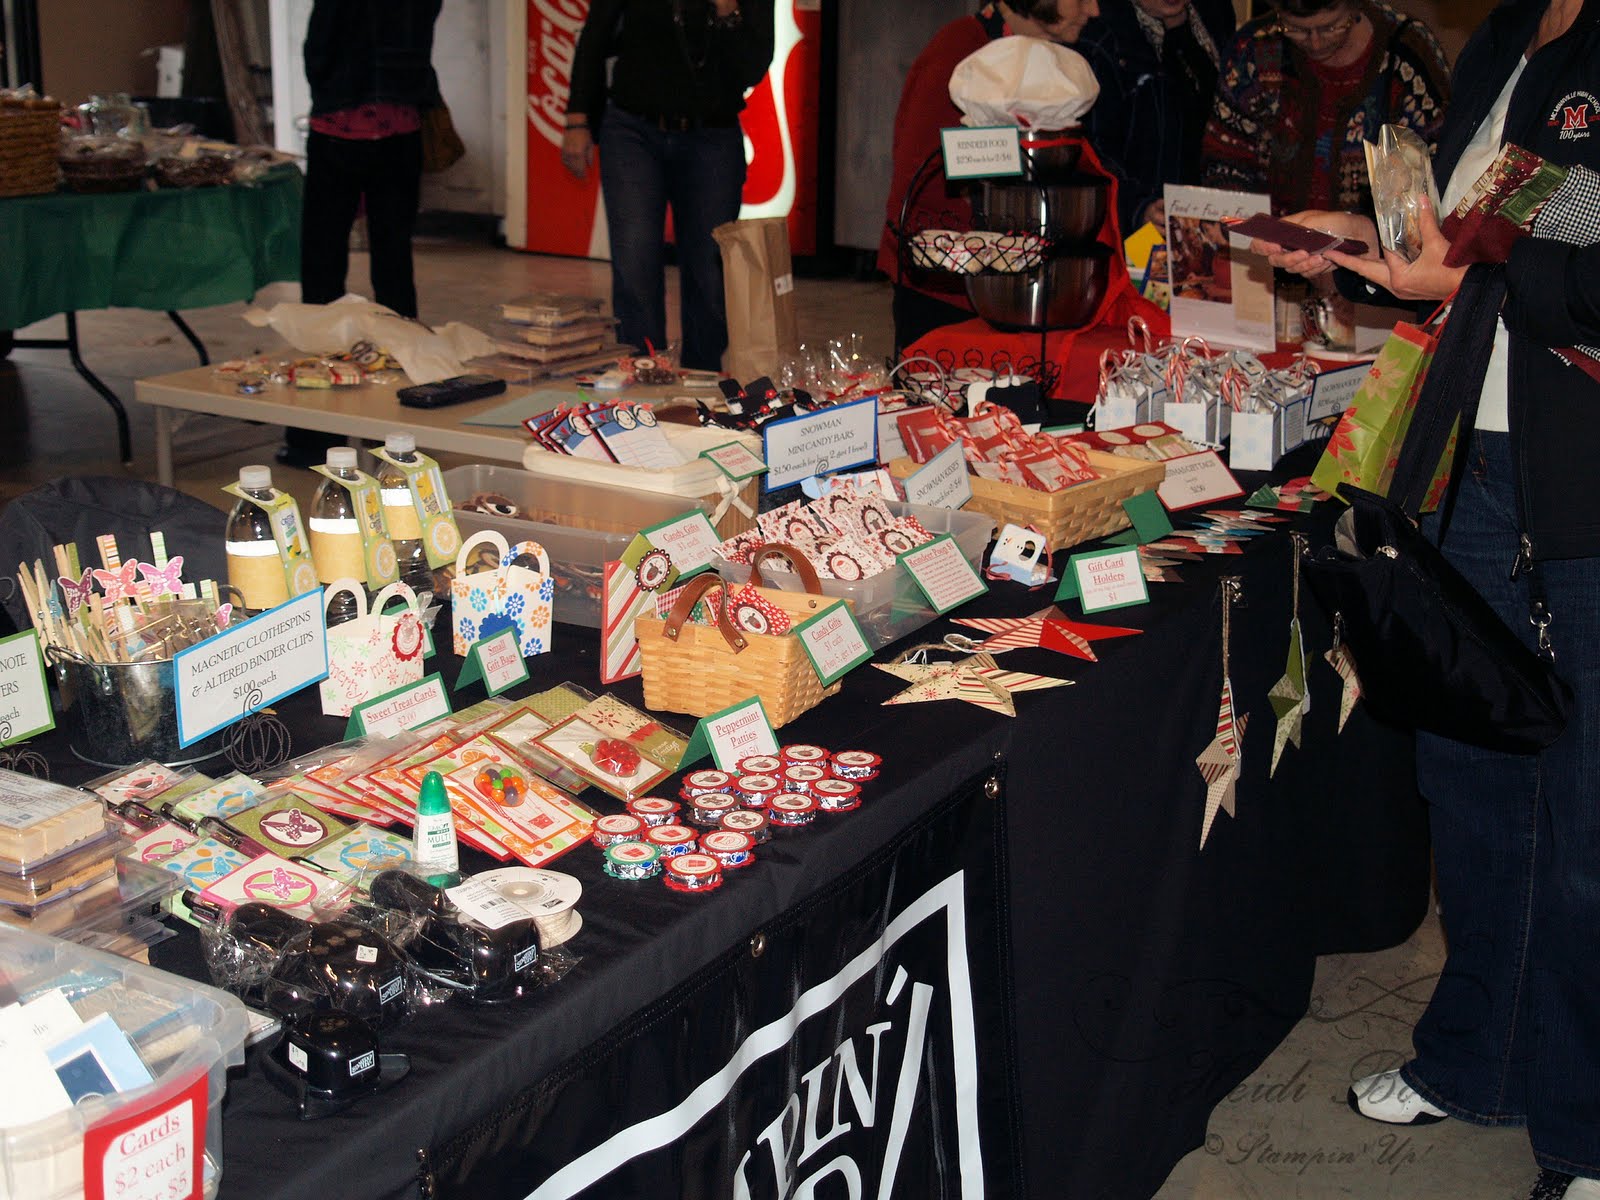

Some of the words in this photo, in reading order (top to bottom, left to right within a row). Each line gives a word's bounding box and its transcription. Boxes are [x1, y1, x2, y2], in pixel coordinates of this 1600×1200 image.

[1562, 104, 1588, 130] M
[800, 418, 842, 437] SNOWMAN
[788, 443, 805, 456] MINI
[805, 436, 832, 452] CANDY
[832, 430, 854, 441] BARS
[916, 471, 945, 500] SNOWMAN
[663, 529, 684, 542] Candy
[1088, 561, 1103, 572] Gift
[1104, 558, 1124, 569] Card
[1093, 572, 1125, 585] Holders
[191, 647, 244, 677] MAGNETIC
[244, 610, 312, 653] CLOTHESPINS
[812, 626, 828, 641] Candy
[488, 640, 506, 654] Small
[0, 653, 28, 673] NOTE
[192, 685, 203, 698] &
[204, 665, 250, 693] ALTERED
[249, 647, 288, 675] BINDER
[286, 631, 315, 657] CLIPS
[487, 660, 500, 672] Gift
[255, 671, 278, 687] each
[366, 706, 392, 723] Sweet
[391, 698, 413, 712] Treat
[413, 687, 437, 703] Cards
[715, 711, 760, 736] Peppermint
[730, 730, 758, 747] Patties
[120, 1115, 181, 1156] Cards
[115, 1166, 139, 1195] $2
[145, 1141, 187, 1178] each
[168, 1170, 187, 1199] $5
